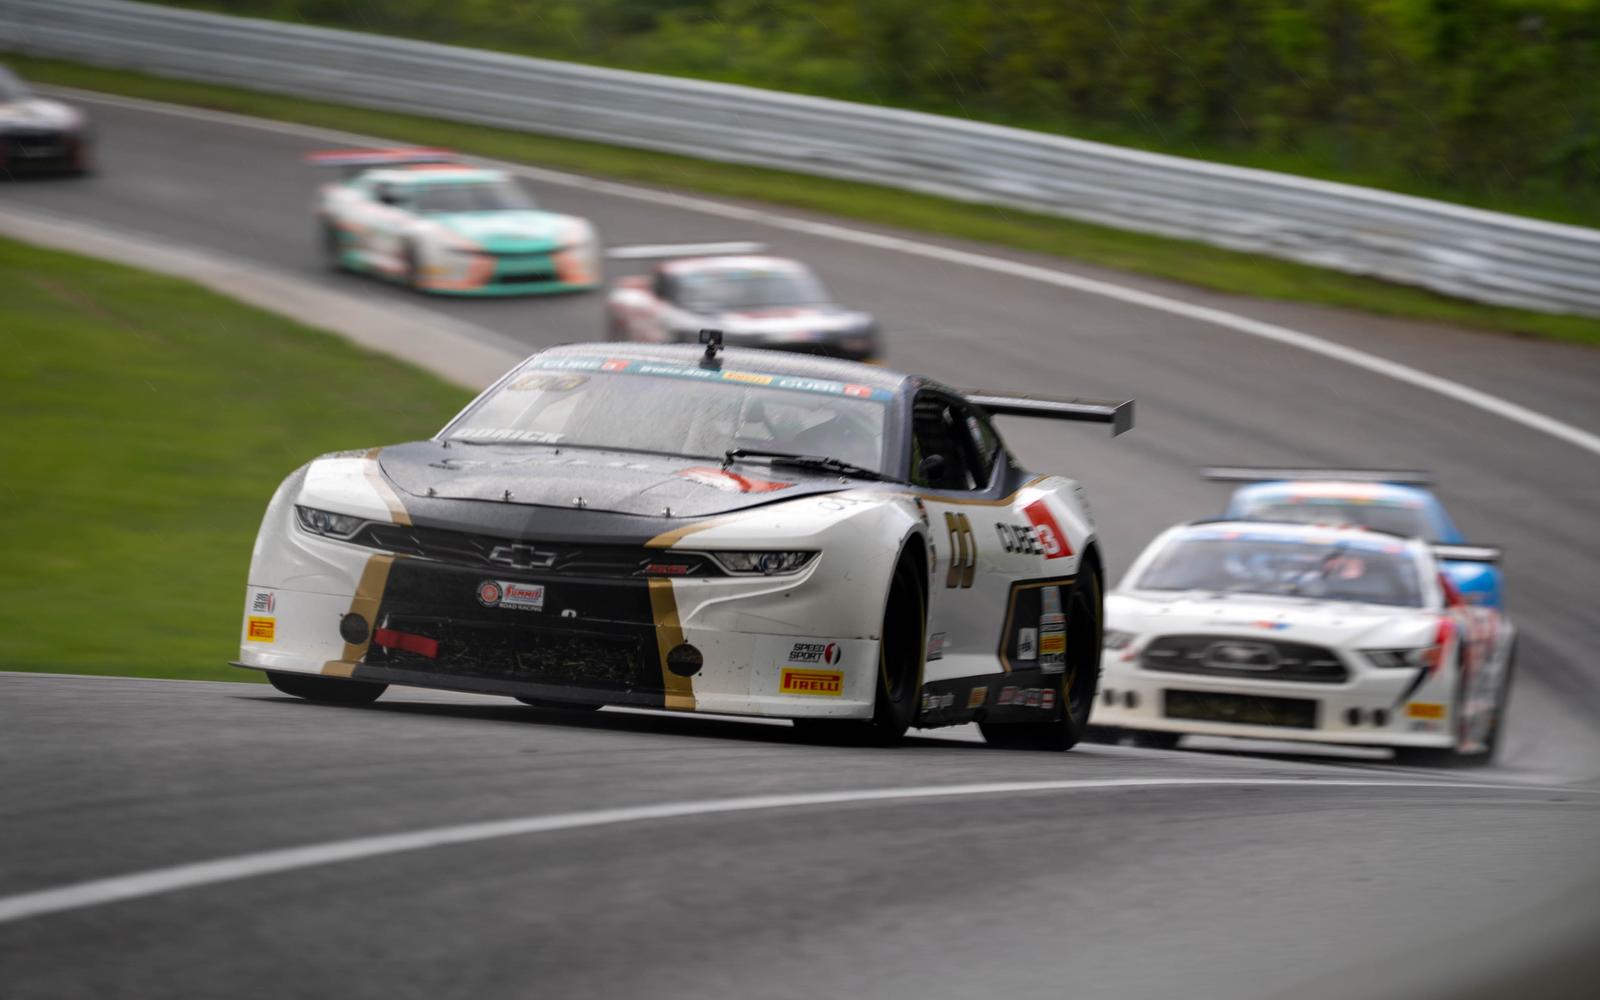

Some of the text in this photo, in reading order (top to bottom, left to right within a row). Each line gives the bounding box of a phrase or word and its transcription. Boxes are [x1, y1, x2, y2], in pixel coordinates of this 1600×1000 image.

[793, 643, 825, 653] SPEED
[789, 651, 823, 662] SPORT
[784, 672, 840, 692] PIRELLI
